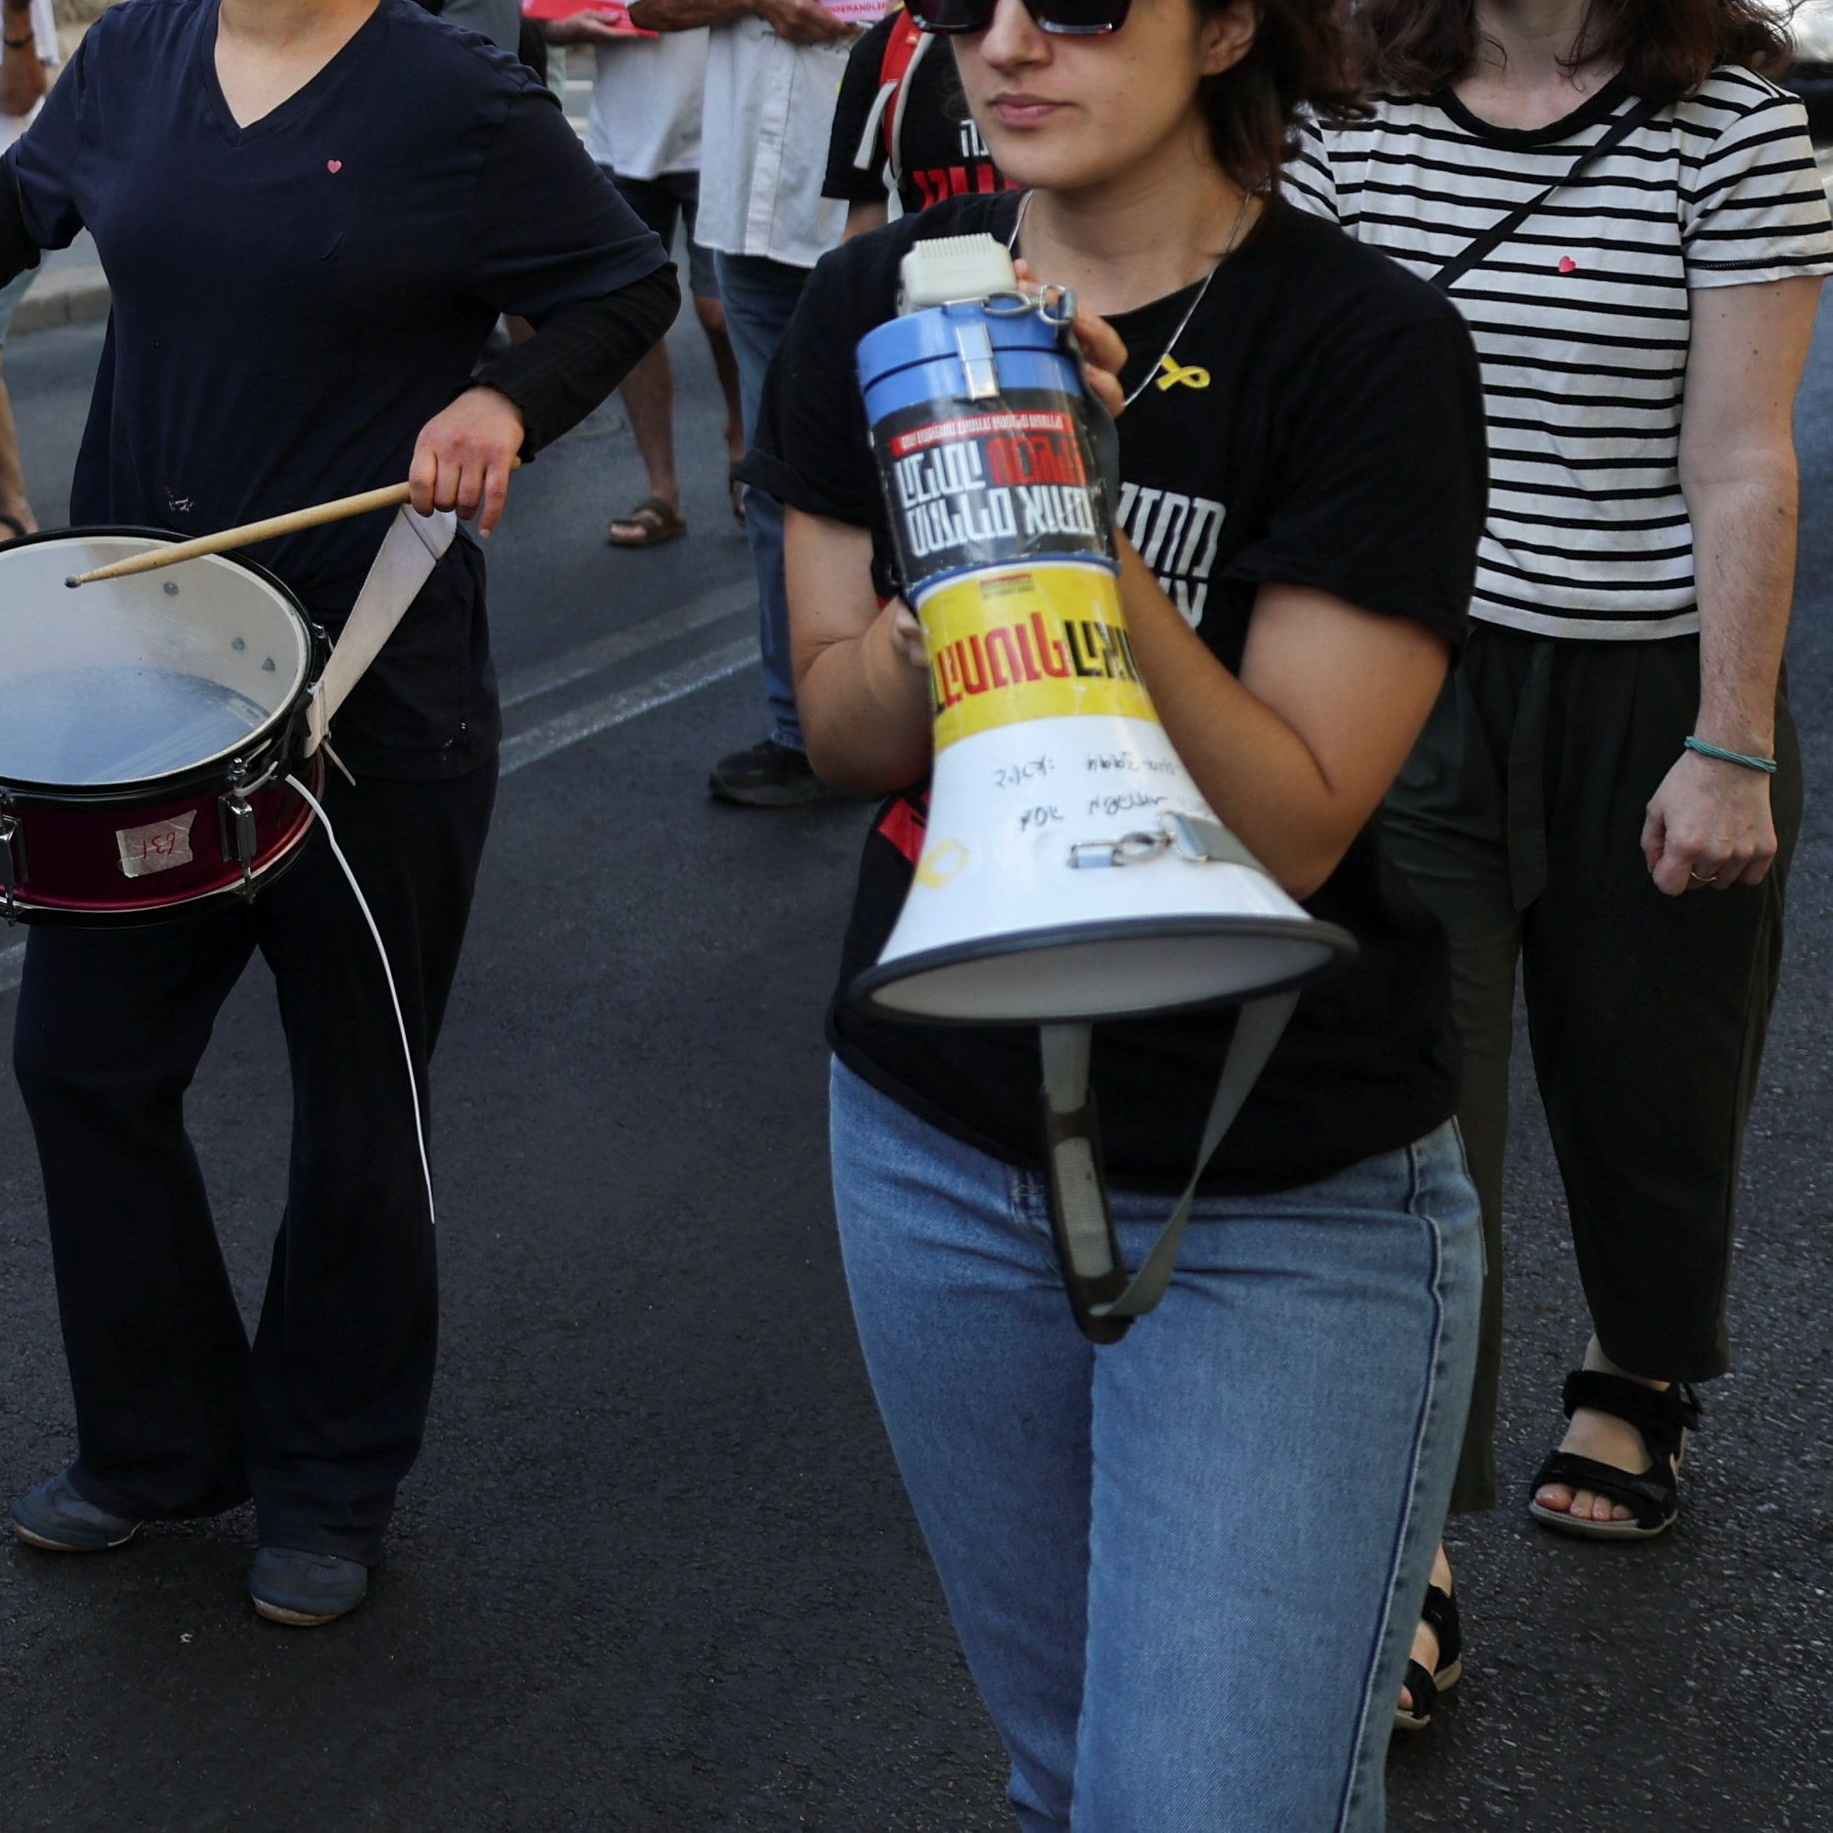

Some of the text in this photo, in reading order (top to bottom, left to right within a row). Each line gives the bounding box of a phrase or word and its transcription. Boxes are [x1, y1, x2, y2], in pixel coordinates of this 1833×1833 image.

[894, 440, 986, 509] הביתה
[905, 485, 1096, 558] מחזירים אותם
[935, 611, 1071, 708] החטוף
